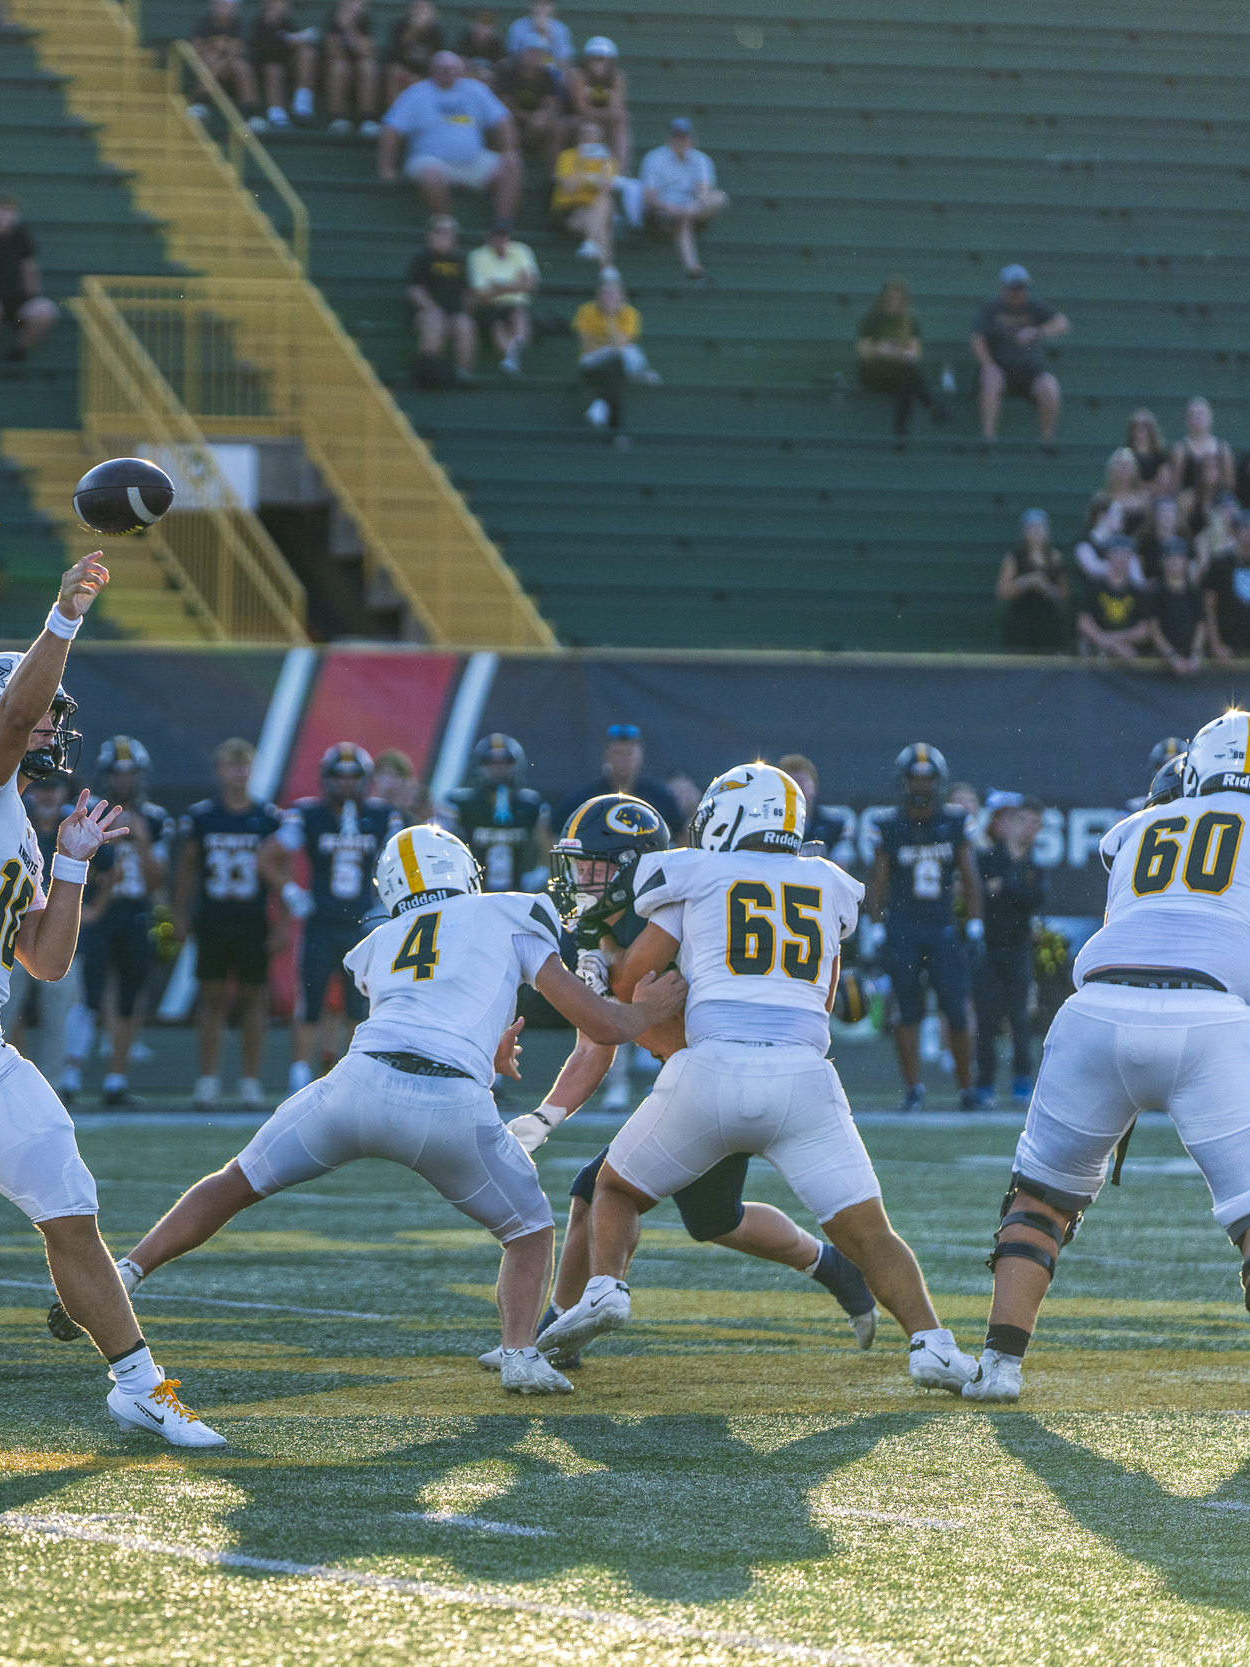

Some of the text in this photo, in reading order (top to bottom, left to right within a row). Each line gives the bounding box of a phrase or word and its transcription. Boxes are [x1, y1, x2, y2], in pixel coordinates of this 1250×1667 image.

[1222, 773, 1250, 789] Rid
[773, 808, 784, 817] 65
[1132, 810, 1245, 897] 60
[397, 889, 448, 914] Riddell
[391, 911, 442, 982] 4
[726, 879, 823, 984] 65
